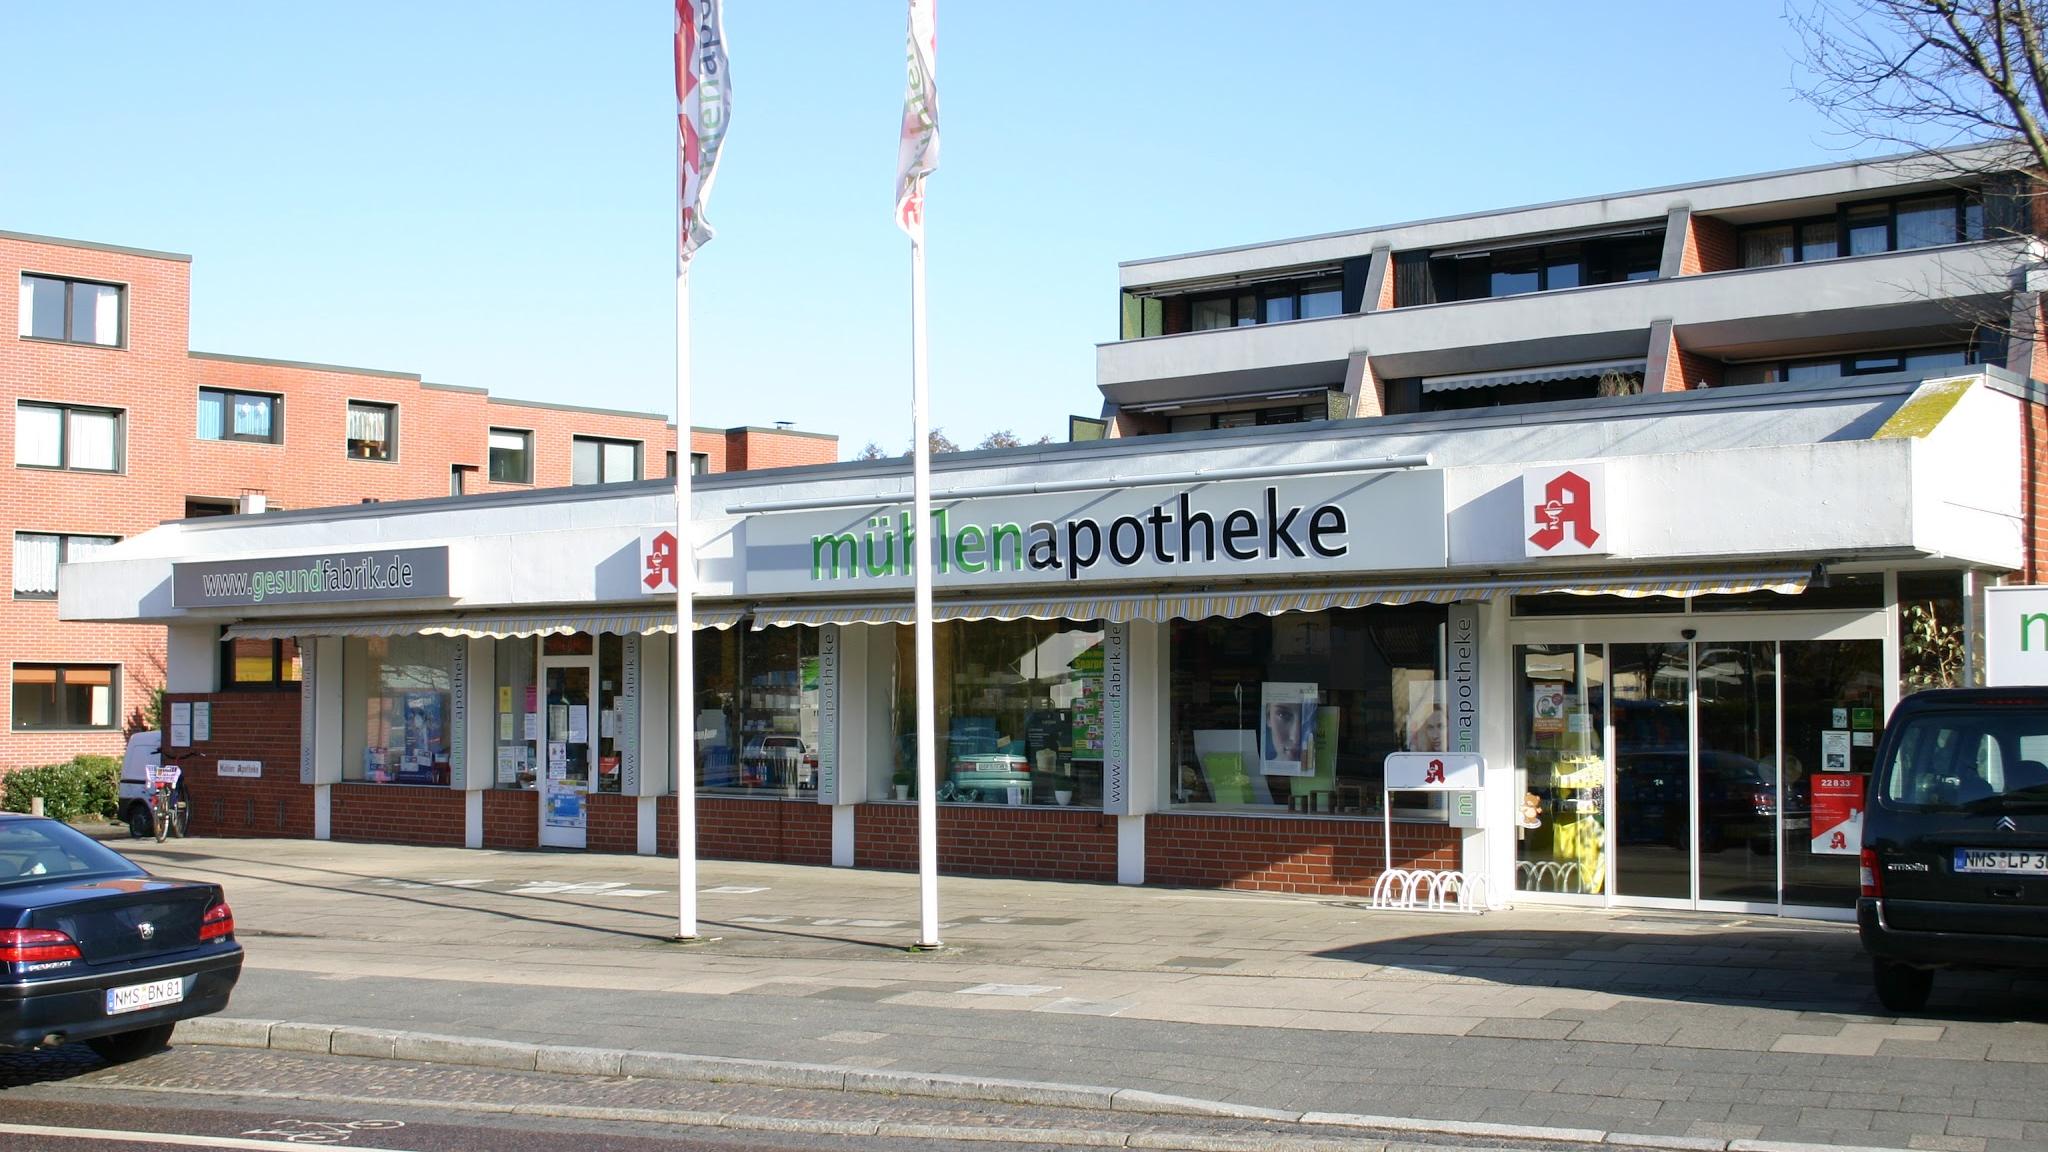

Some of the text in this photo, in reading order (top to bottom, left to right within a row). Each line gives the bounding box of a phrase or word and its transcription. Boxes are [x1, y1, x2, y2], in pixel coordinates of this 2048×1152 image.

[203, 554, 414, 602] www.gesundfabrik.de
[1109, 625, 1123, 803] www.gesundfabrik.de
[2035, 853, 2048, 869] 3
[115, 981, 180, 1006] NMS BN 81
